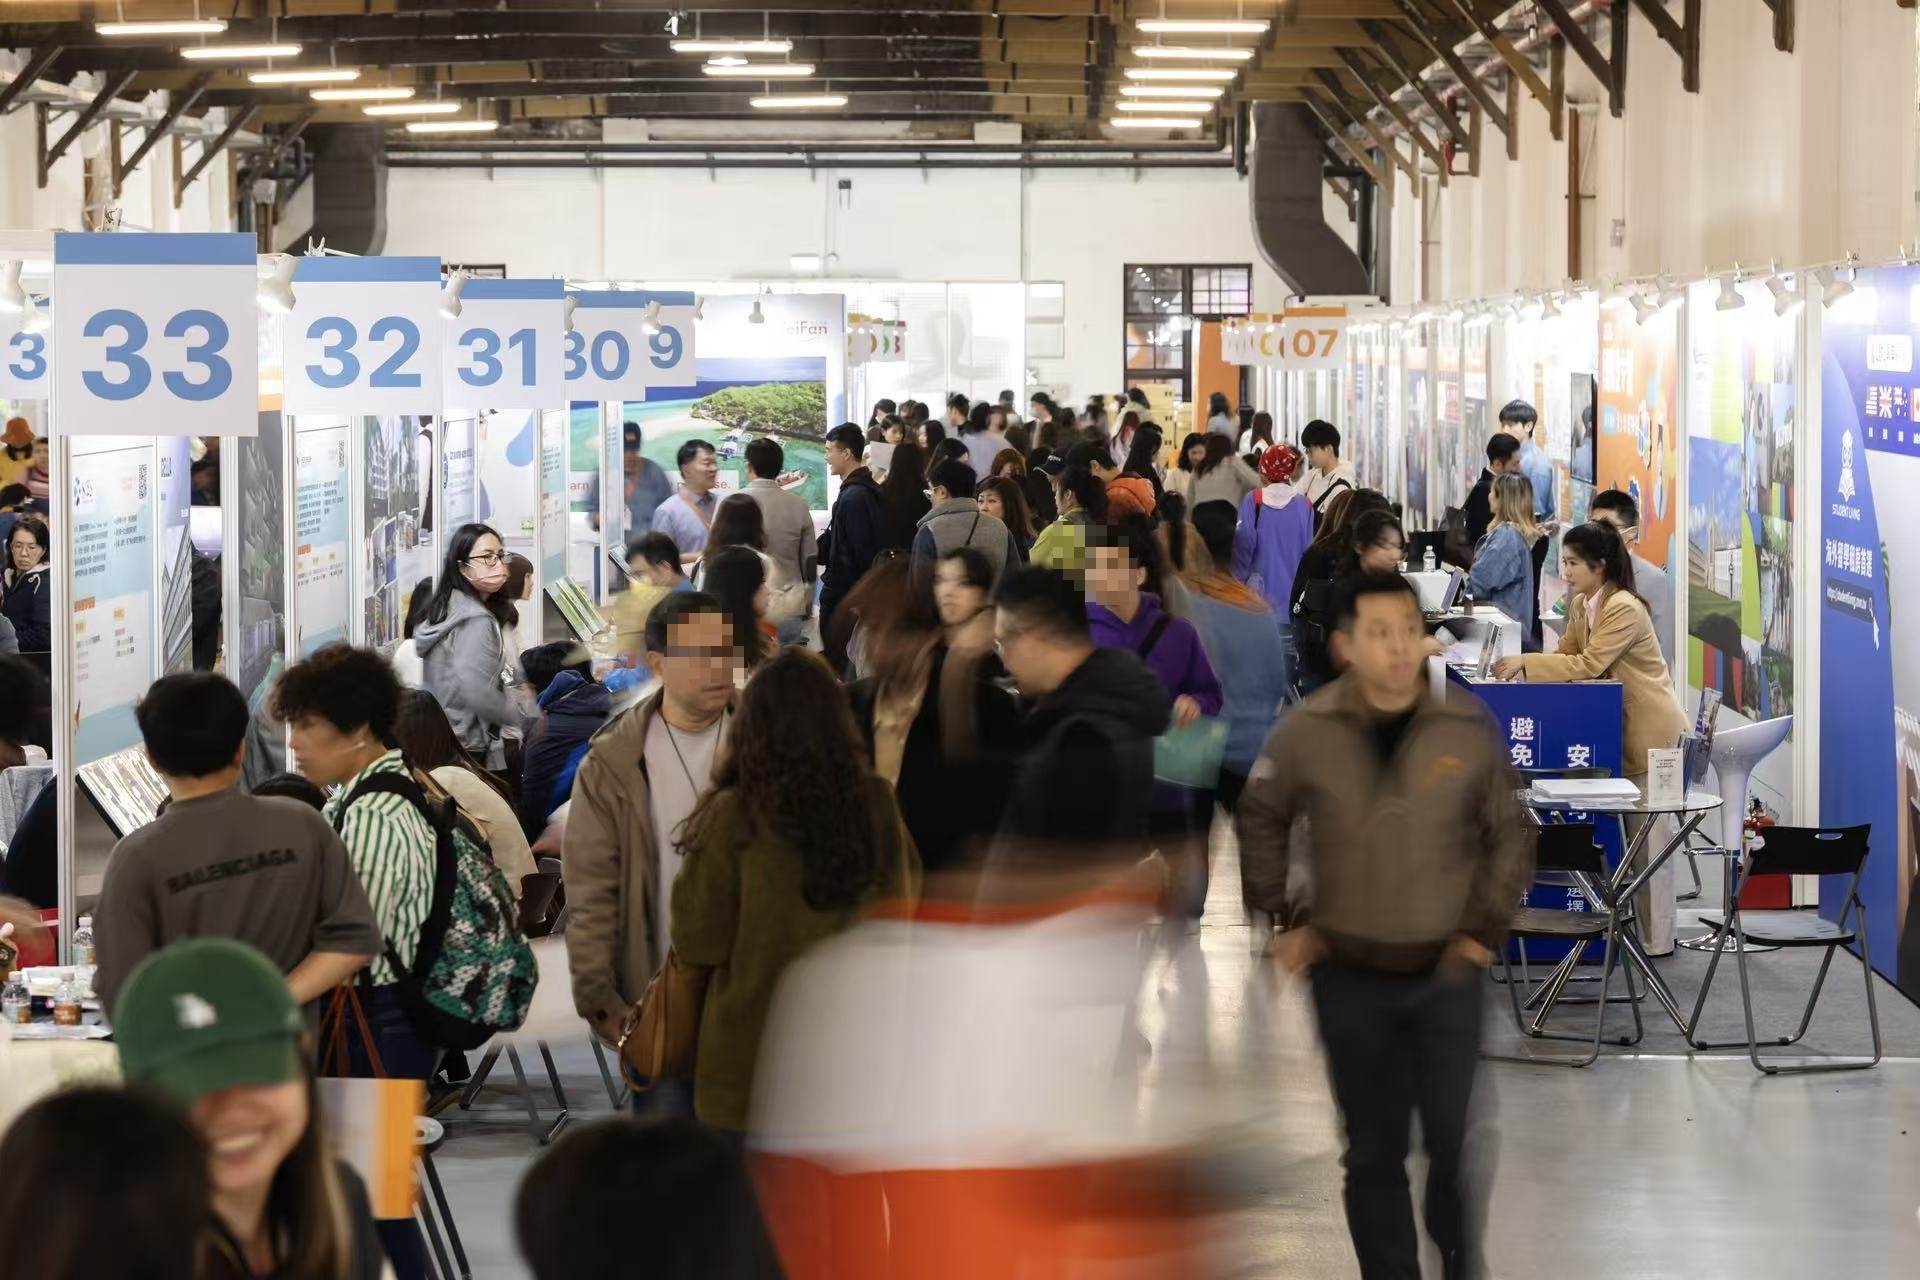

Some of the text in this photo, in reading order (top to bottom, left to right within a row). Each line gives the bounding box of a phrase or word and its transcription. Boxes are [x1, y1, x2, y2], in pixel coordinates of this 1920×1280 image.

[8, 330, 48, 381] 3
[81, 308, 233, 402] 33
[305, 316, 422, 389] 32
[457, 327, 537, 387] 31
[564, 329, 630, 381] 30
[650, 325, 684, 369] 9
[1292, 328, 1339, 358] 07
[569, 482, 589, 491] arn
[1510, 716, 1535, 767] 避免
[1567, 744, 1591, 768] 安
